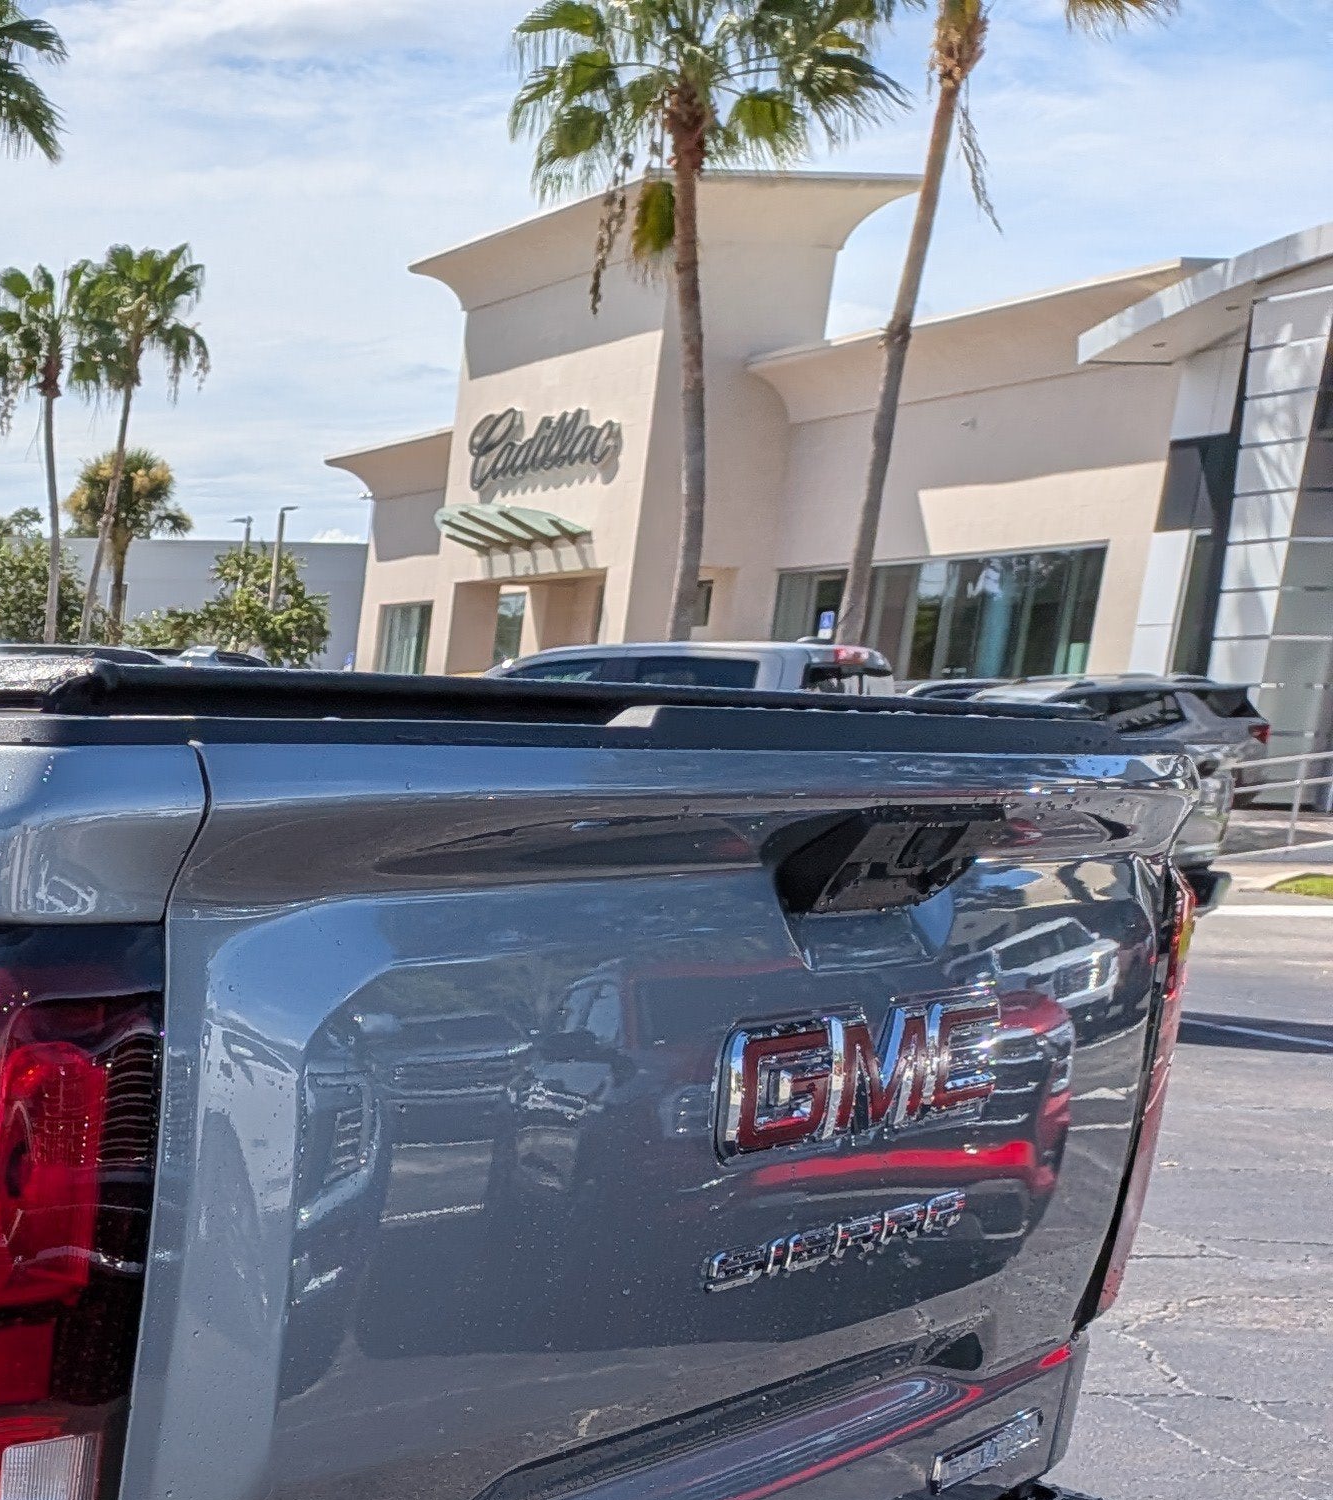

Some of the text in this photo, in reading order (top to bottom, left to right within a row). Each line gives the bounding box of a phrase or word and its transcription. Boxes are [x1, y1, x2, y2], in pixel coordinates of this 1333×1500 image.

[469, 408, 621, 491] Cadillac
[711, 983, 1000, 1164] GMC
[705, 1190, 966, 1292] SIERRA
